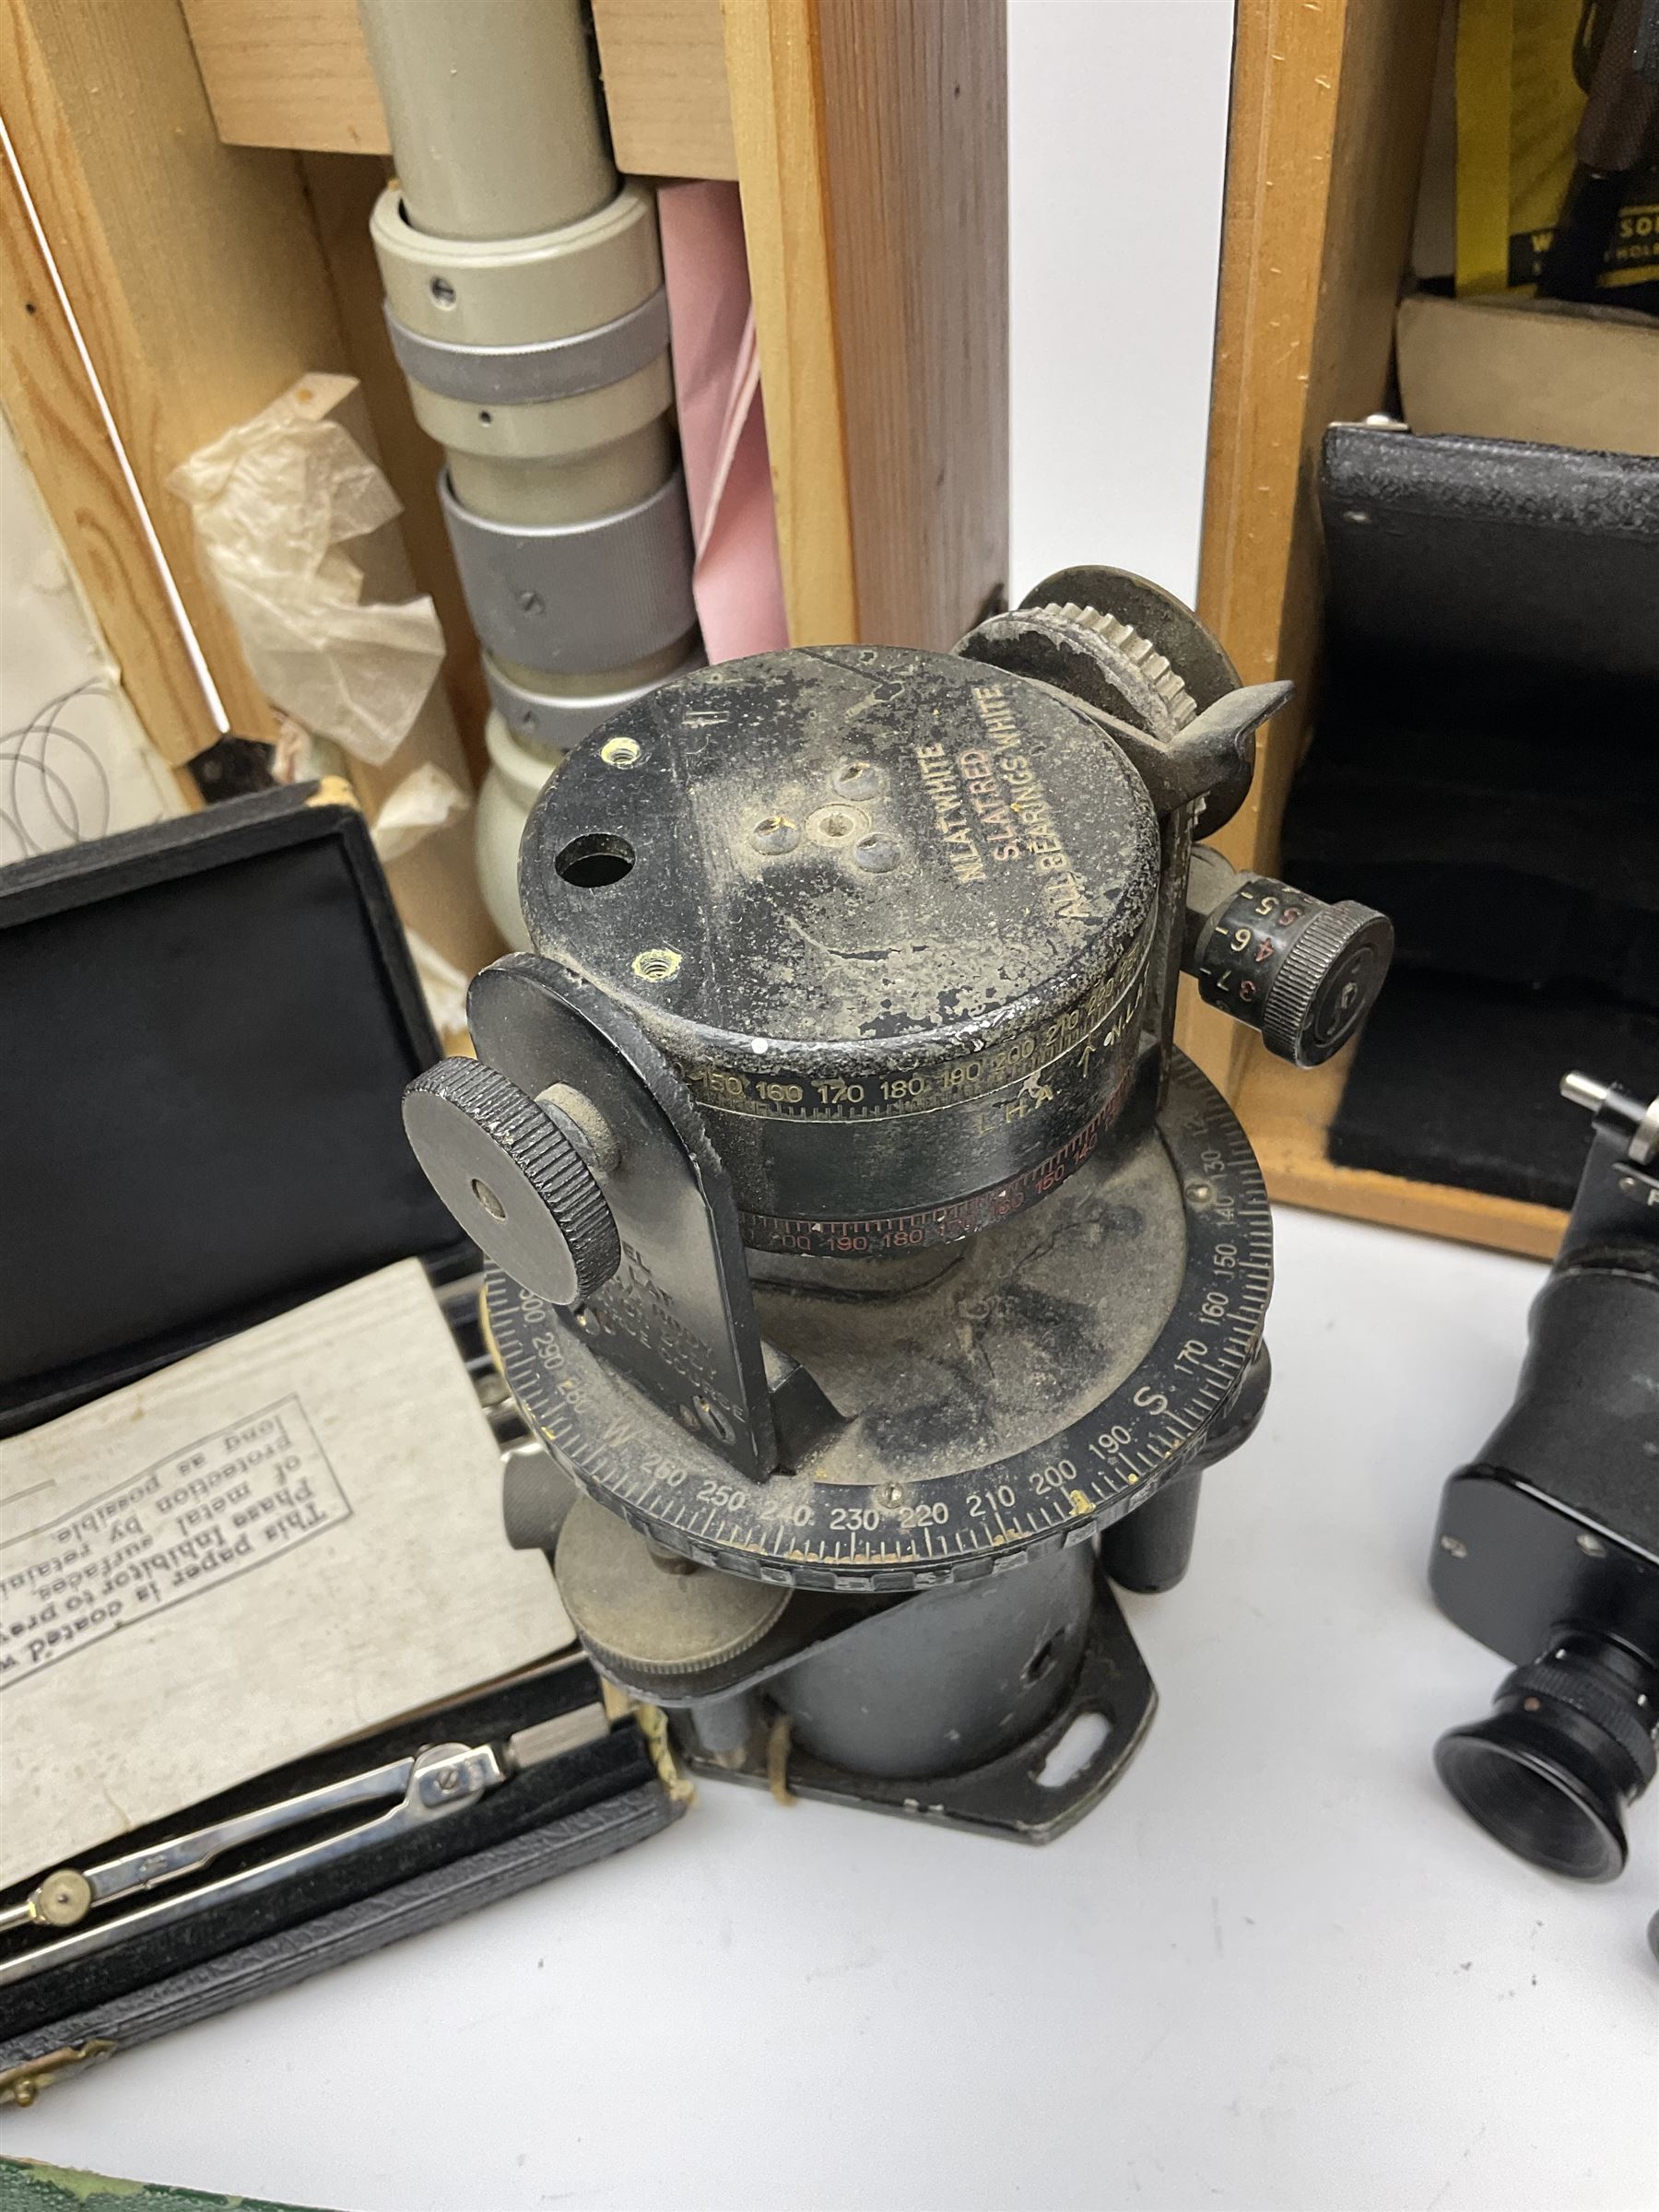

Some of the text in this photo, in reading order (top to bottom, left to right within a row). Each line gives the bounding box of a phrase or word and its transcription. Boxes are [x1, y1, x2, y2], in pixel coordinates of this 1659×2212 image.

[1619, 218, 1659, 237] SO
[916, 742, 961, 814] WHITE
[959, 748, 998, 794] RED
[972, 683, 1090, 919] ALL BEARINGS WHITE
[756, 1081, 804, 1103] 160
[818, 1084, 865, 1104] 170
[880, 1077, 925, 1100] 180
[943, 1062, 982, 1089] 190
[1201, 1149, 1226, 1181] 130
[828, 1236, 868, 1251] 190
[883, 1229, 923, 1248] 180
[1035, 1164, 1065, 1194] 150
[1217, 1195, 1235, 1226] 140
[1213, 1243, 1238, 1279] 150
[1199, 1291, 1230, 1326] 160
[533, 1333, 564, 1371] 290
[1174, 1339, 1208, 1375] 170
[1133, 1385, 1169, 1416] S
[224, 1413, 284, 1453] long
[1089, 1425, 1132, 1461] 190
[155, 1434, 293, 1514] protection
[177, 1453, 208, 1475] as
[276, 1455, 302, 1485] of
[642, 1456, 687, 1488] 260
[1029, 1460, 1077, 1495] 200
[177, 1481, 252, 1537] metal
[231, 1477, 316, 1528] Phase
[696, 1481, 747, 1512] 250
[966, 1485, 1016, 1517] 210
[109, 1514, 144, 1544] by
[263, 1500, 328, 1544] This
[830, 1508, 879, 1531] 230
[900, 1502, 949, 1529] 220
[101, 1524, 227, 1595] Inhibitor
[171, 1533, 256, 1588] paper
[65, 1587, 100, 1611] to
[135, 1582, 164, 1604] is
[26, 1600, 124, 1665] coated
